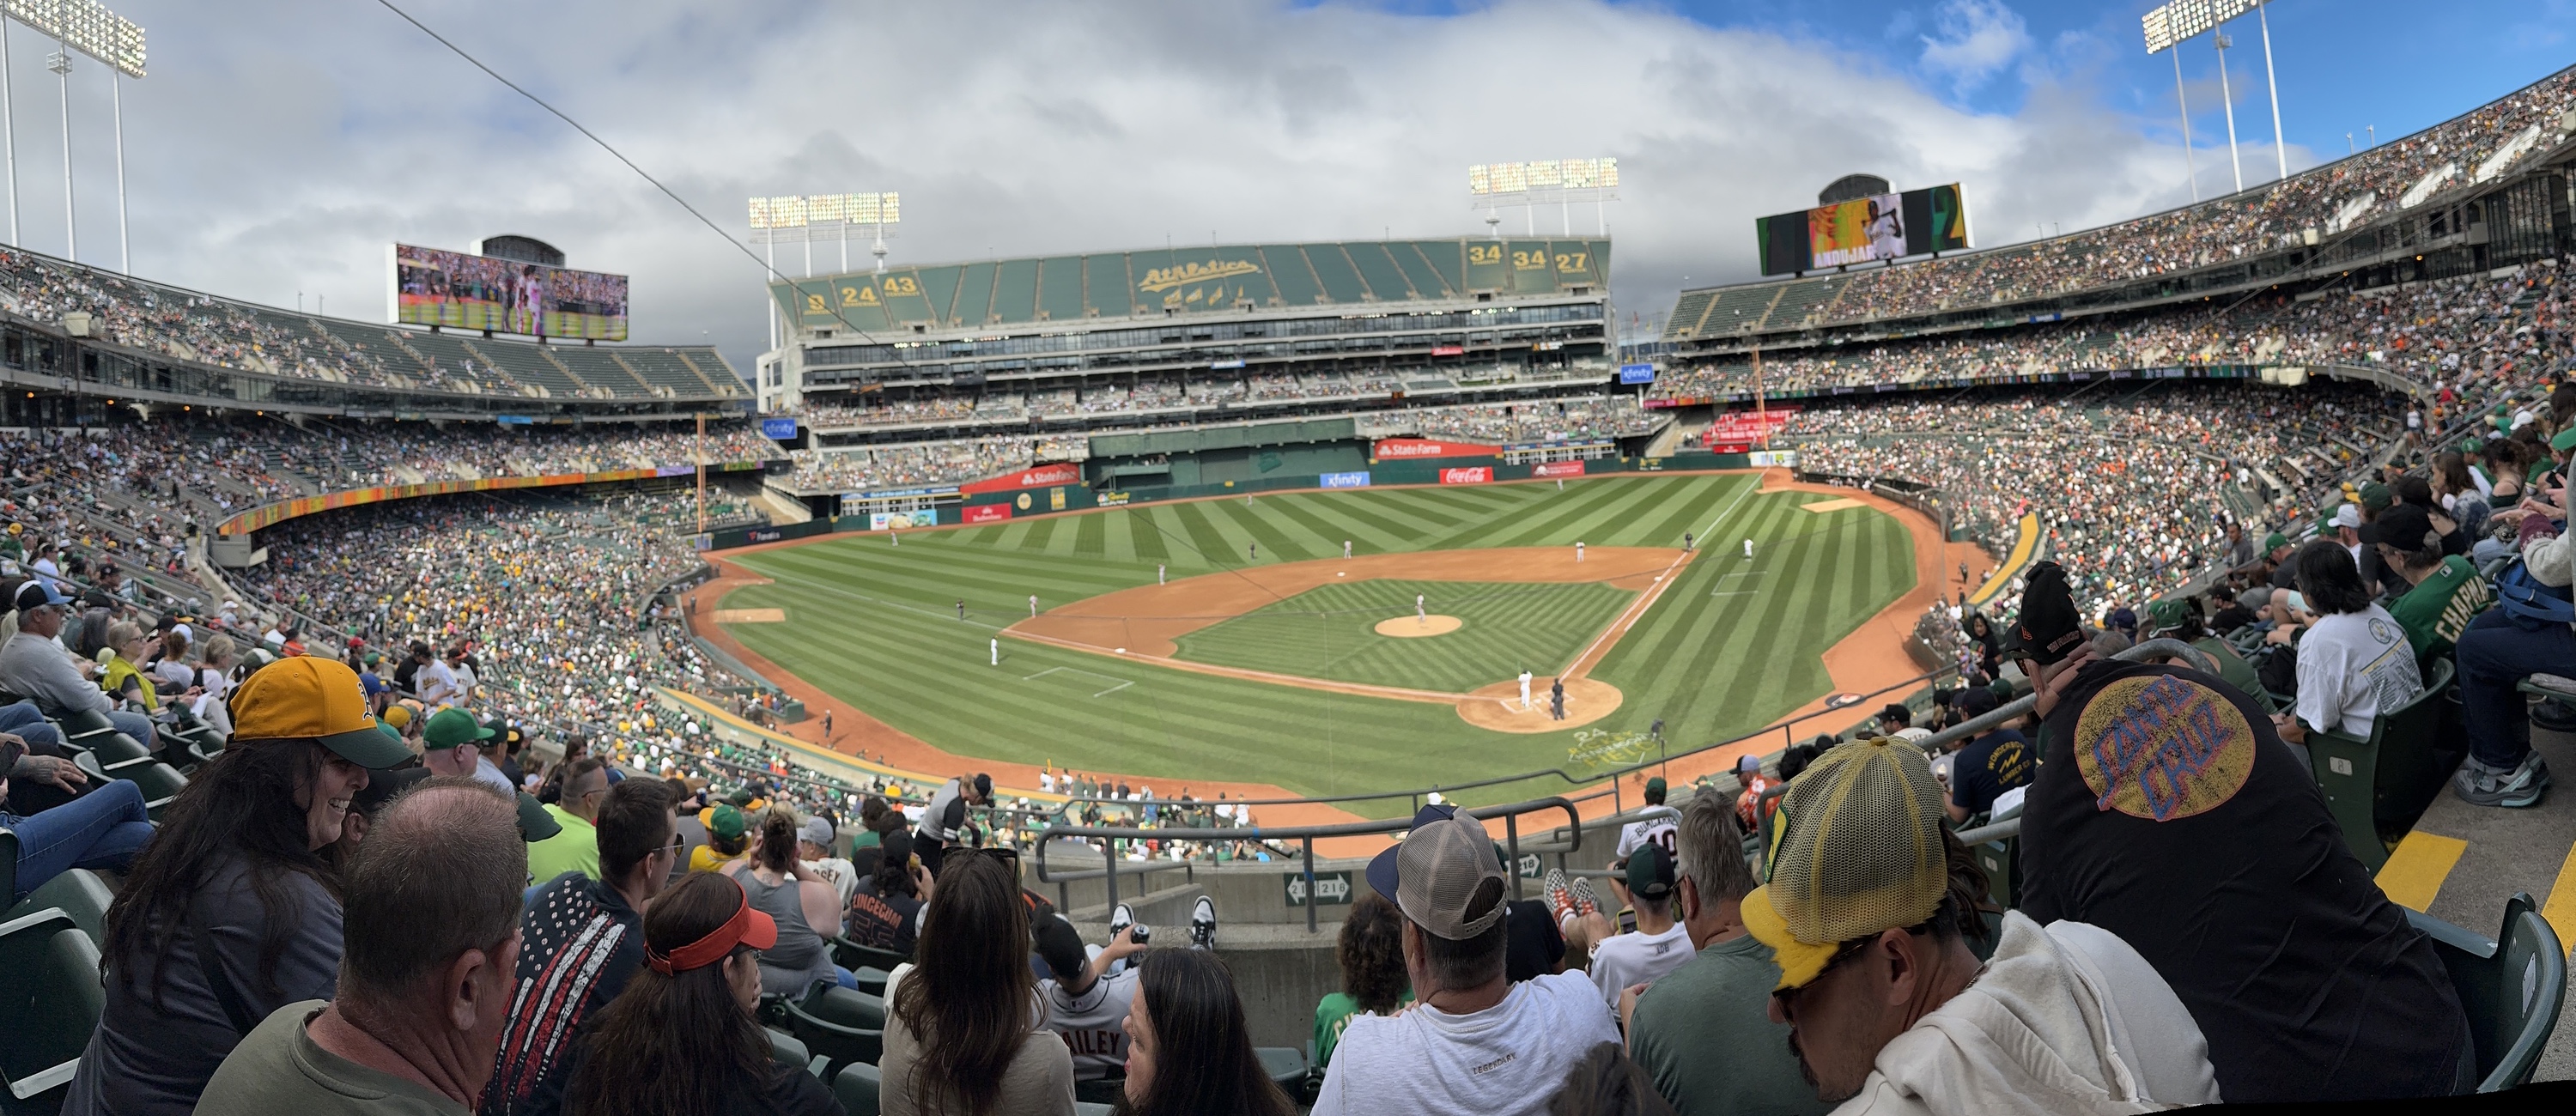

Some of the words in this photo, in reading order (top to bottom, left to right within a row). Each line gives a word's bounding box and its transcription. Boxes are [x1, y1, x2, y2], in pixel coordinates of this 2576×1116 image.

[1469, 245, 1502, 261] 34
[1512, 250, 1546, 266] 34
[1555, 253, 1587, 269] 27
[1138, 259, 1259, 292] Athletics
[884, 277, 917, 293] 43
[807, 294, 824, 310] 9
[841, 287, 877, 301] 24
[1623, 367, 1651, 379] xfinity
[765, 422, 794, 434] xfinity
[1393, 445, 1416, 455] State
[1418, 444, 1442, 454] Farm
[1035, 471, 1055, 484] State
[1328, 475, 1362, 488] xfinity
[1446, 468, 1485, 482] Coca-Cola
[2435, 575, 2489, 644] CHAPMA
[1574, 728, 1607, 747] 24
[2092, 674, 2199, 811] SANTA
[2137, 700, 2236, 822] CRUZ
[2337, 759, 2344, 773] 8
[1322, 882, 1346, 893] 218
[853, 893, 902, 929] LINCECUM
[1061, 1030, 1121, 1055] AILEY
